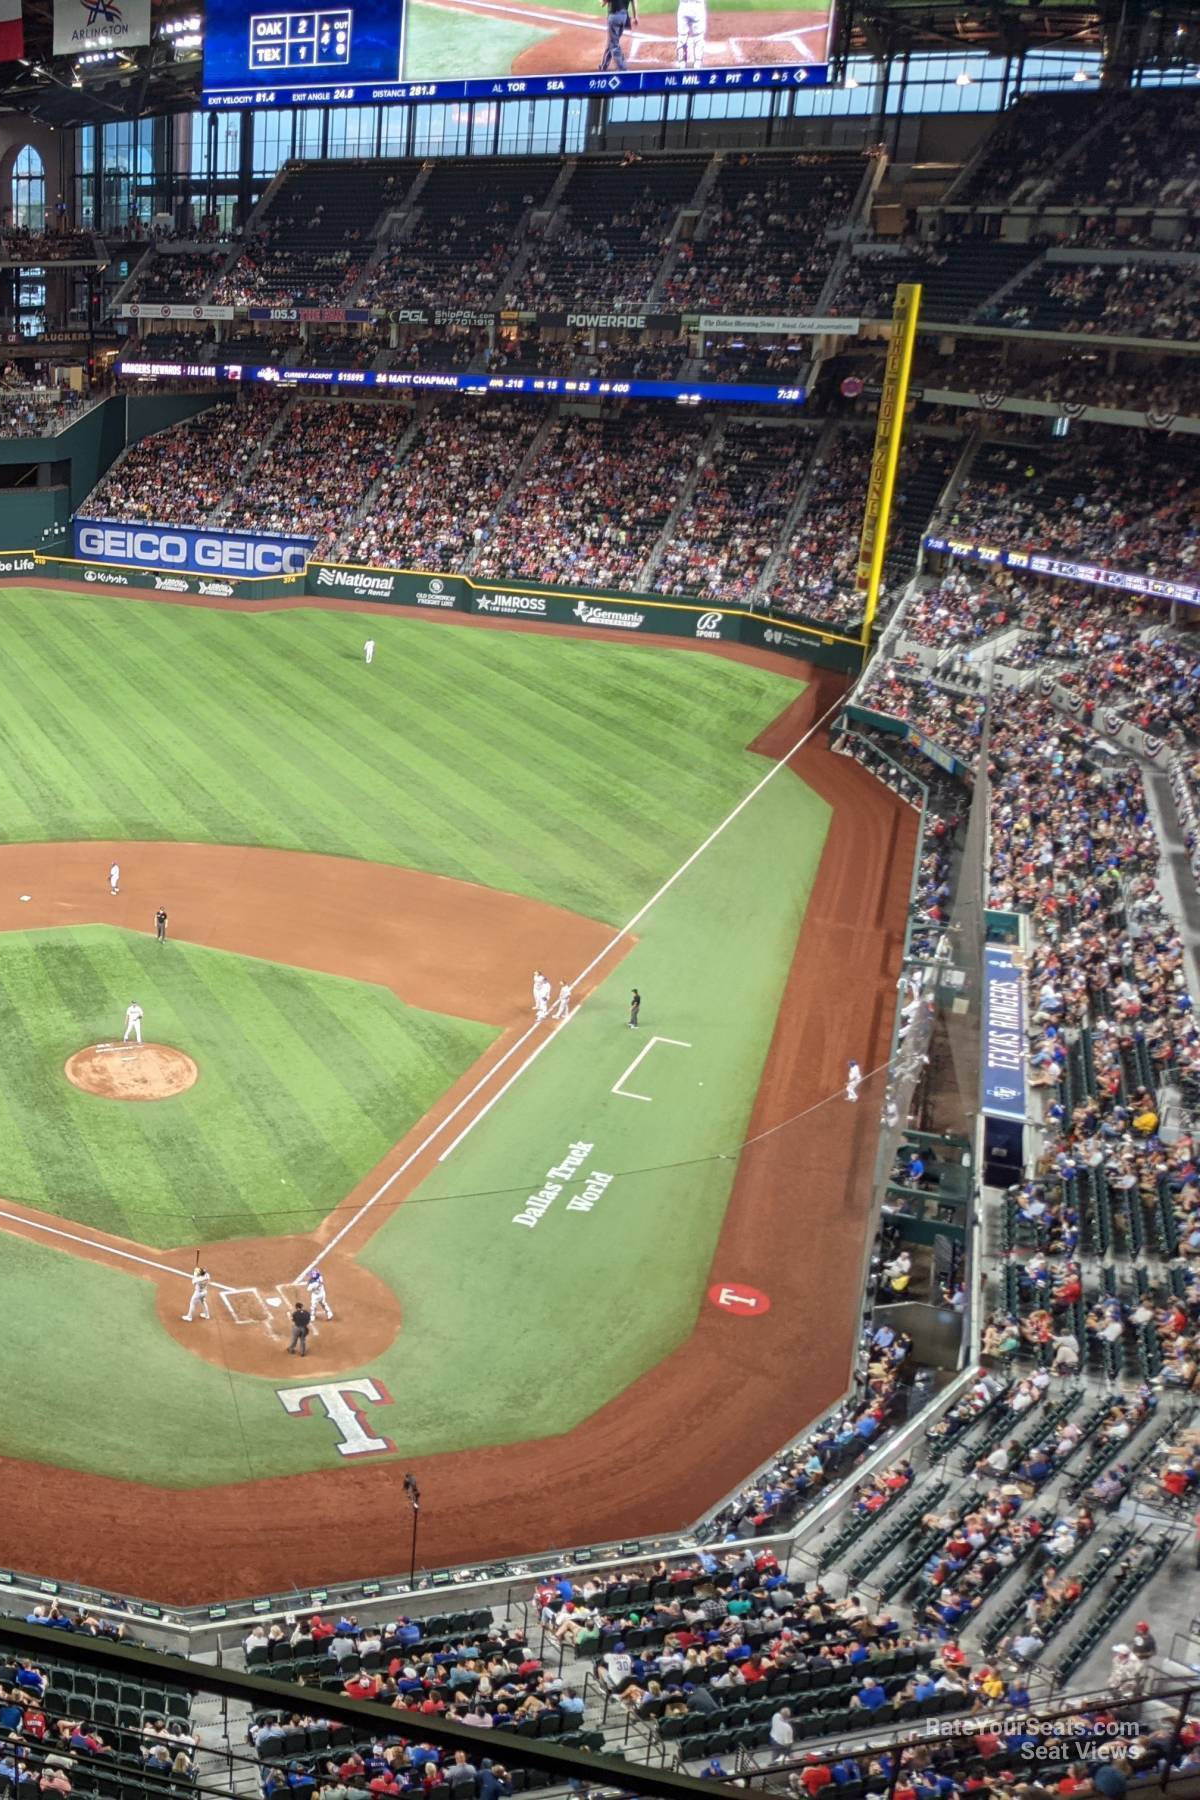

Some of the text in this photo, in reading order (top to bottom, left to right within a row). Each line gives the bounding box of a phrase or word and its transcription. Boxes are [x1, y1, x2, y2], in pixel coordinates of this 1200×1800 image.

[256, 20, 308, 37] OAK 2
[334, 21, 349, 30] OUT
[71, 24, 129, 41] ARLINGTON
[320, 33, 330, 45] 4
[256, 47, 307, 62] TEX 1
[492, 79, 607, 93] AL TOR SEA 9:10
[664, 76, 678, 86] NL
[681, 74, 700, 85] MIL
[709, 74, 717, 84] 2
[725, 74, 742, 83] PIT
[207, 92, 275, 105] EXIT VELOCITY 81.4
[292, 89, 354, 102] EXIT ANGLE 24.8
[372, 86, 436, 99] DISTANCE 281.8
[270, 308, 298, 320] 105.3
[399, 310, 429, 323] PGL
[566, 314, 648, 329] POWERADE
[388, 374, 412, 385] MATT
[412, 375, 458, 387] CHAPMAN
[547, 381, 558, 390] 15
[579, 382, 591, 392] 53
[612, 384, 629, 393] 400
[776, 388, 800, 400] 7:38
[79, 527, 188, 564] GEICO
[194, 538, 312, 575] GEICO
[13, 558, 35, 571] Life
[96, 571, 129, 586] Kubota
[334, 569, 394, 590] National
[354, 587, 390, 598] Car Rental
[593, 607, 645, 623] Germania
[695, 630, 720, 640] SPORTS
[989, 979, 1019, 1030] RANGERS
[988, 1033, 1020, 1071] TEXAS
[511, 1139, 594, 1229] Dallas Truck
[565, 1170, 615, 1213] World
[718, 1287, 757, 1308] T
[274, 1377, 398, 1459] T
[615, 1661, 629, 1672] 30
